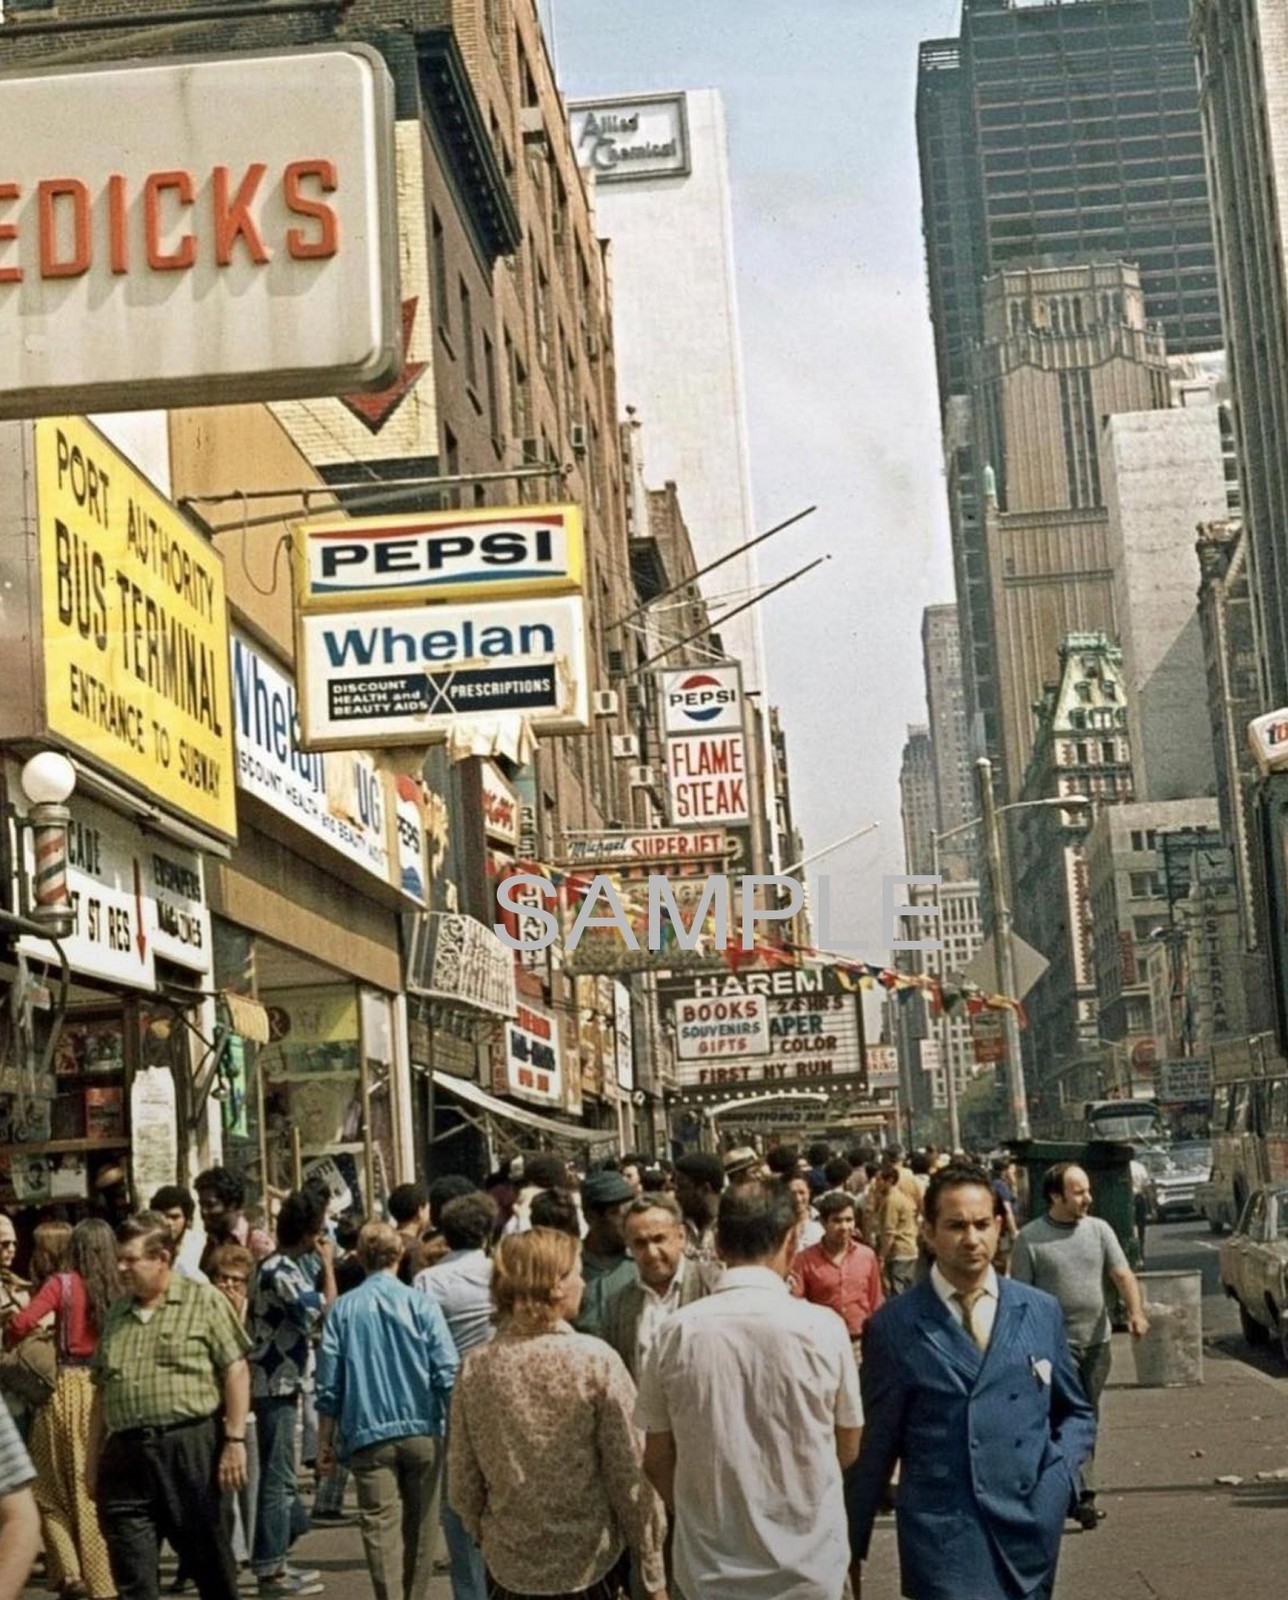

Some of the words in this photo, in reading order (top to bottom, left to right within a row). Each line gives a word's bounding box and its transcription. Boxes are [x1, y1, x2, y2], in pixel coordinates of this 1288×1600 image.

[57, 428, 110, 530] PORT
[127, 498, 214, 625] AUTHORITY
[321, 530, 553, 578] PEPSI
[55, 518, 108, 651] BUS
[116, 570, 222, 738] TERMINAL
[323, 621, 555, 668] Whelan
[333, 680, 407, 694] DISCOUNT
[333, 692, 388, 705] HEALTH
[393, 691, 421, 700] and
[450, 679, 551, 699] PRESCRIPTIONS
[669, 690, 736, 707] PEPSI
[333, 702, 392, 716] BEAUTY
[394, 701, 429, 711] AIDS
[71, 663, 145, 755] ENTRANCE
[152, 720, 171, 769] TO
[178, 738, 220, 799] SUBWAY
[240, 750, 282, 790] SCOUNT
[672, 739, 743, 778] FLAME
[353, 762, 382, 836] UG
[676, 779, 746, 818] STEAK
[68, 820, 100, 876] CADE
[695, 966, 823, 998] HAREM
[683, 1001, 758, 1023] BOOKS
[682, 1021, 761, 1039] SOUVENIRS
[699, 1037, 747, 1054] GIFTS
[780, 1035, 838, 1053] COLOR
[699, 1067, 750, 1084] FIRST
[796, 1059, 833, 1077] RUN
